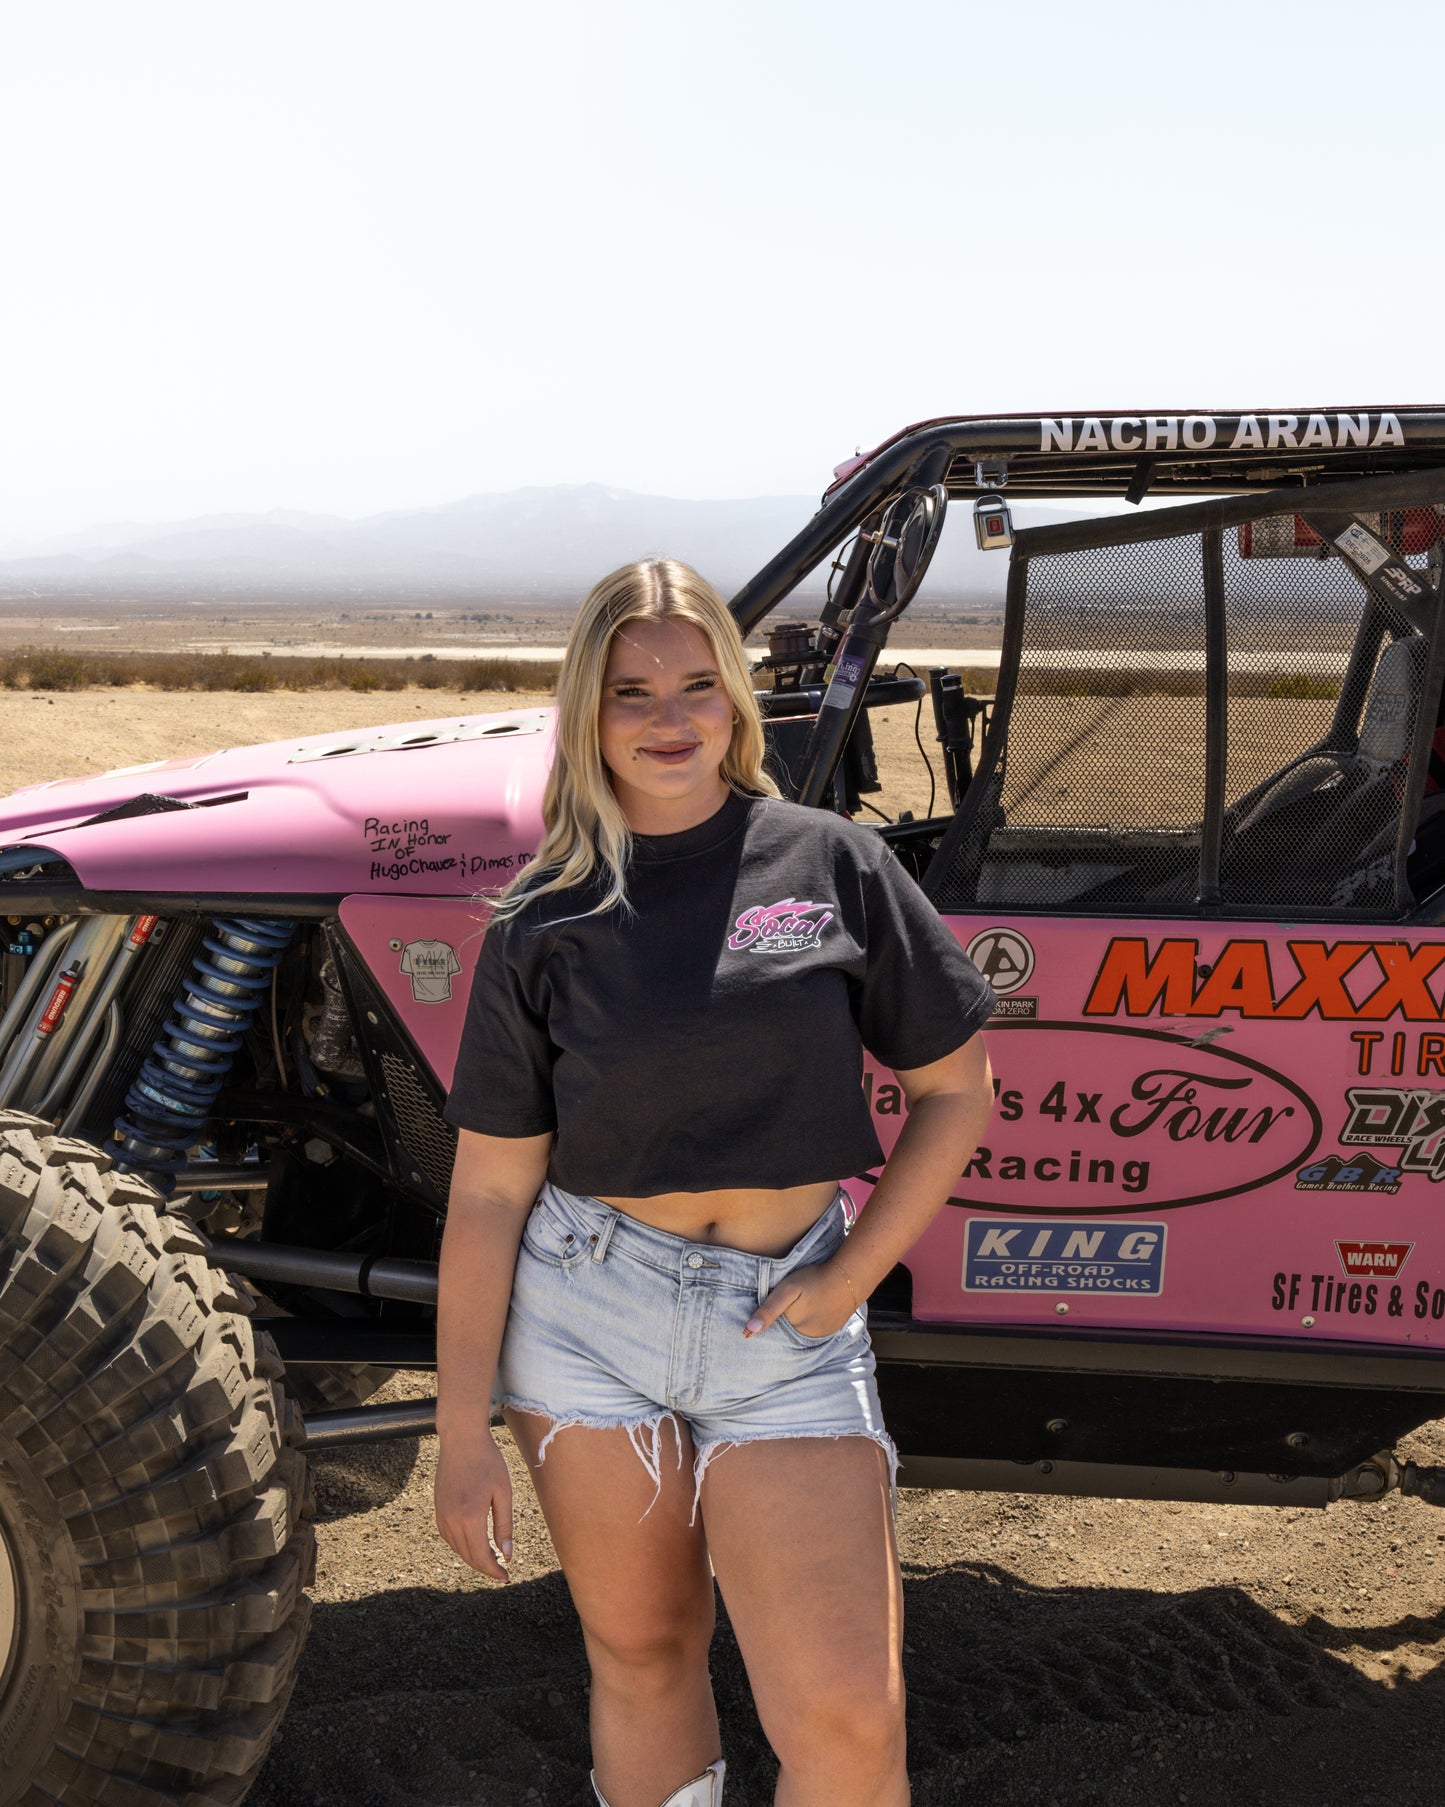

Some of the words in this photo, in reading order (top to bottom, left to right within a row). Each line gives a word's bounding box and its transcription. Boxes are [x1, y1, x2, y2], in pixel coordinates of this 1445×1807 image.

[1040, 416, 1217, 451] NACHO
[1229, 413, 1405, 449] ARANA
[364, 817, 429, 838] Racing
[370, 838, 400, 852] IN
[407, 833, 452, 847] Honor
[394, 846, 415, 860] OF
[1083, 937, 1445, 1022] MAXX
[1007, 1007, 1030, 1015] ZERO
[1011, 1000, 1034, 1009] PARK
[1109, 1069, 1295, 1144] Four
[1346, 1135, 1373, 1143] RACE
[961, 1147, 1150, 1193] Racing
[1296, 1181, 1324, 1189] Gomez
[1327, 1182, 1364, 1190] Brothers
[1367, 1183, 1398, 1193] Racing
[976, 1228, 1159, 1260] KING
[1347, 1252, 1398, 1267] WARN
[1001, 1263, 1115, 1276] OFF-ROAD
[975, 1275, 1058, 1287] RACING
[1067, 1277, 1151, 1289] SHOCKS
[1272, 1272, 1302, 1310] SF
[1311, 1274, 1379, 1316] Tires
[1388, 1285, 1403, 1317] &
